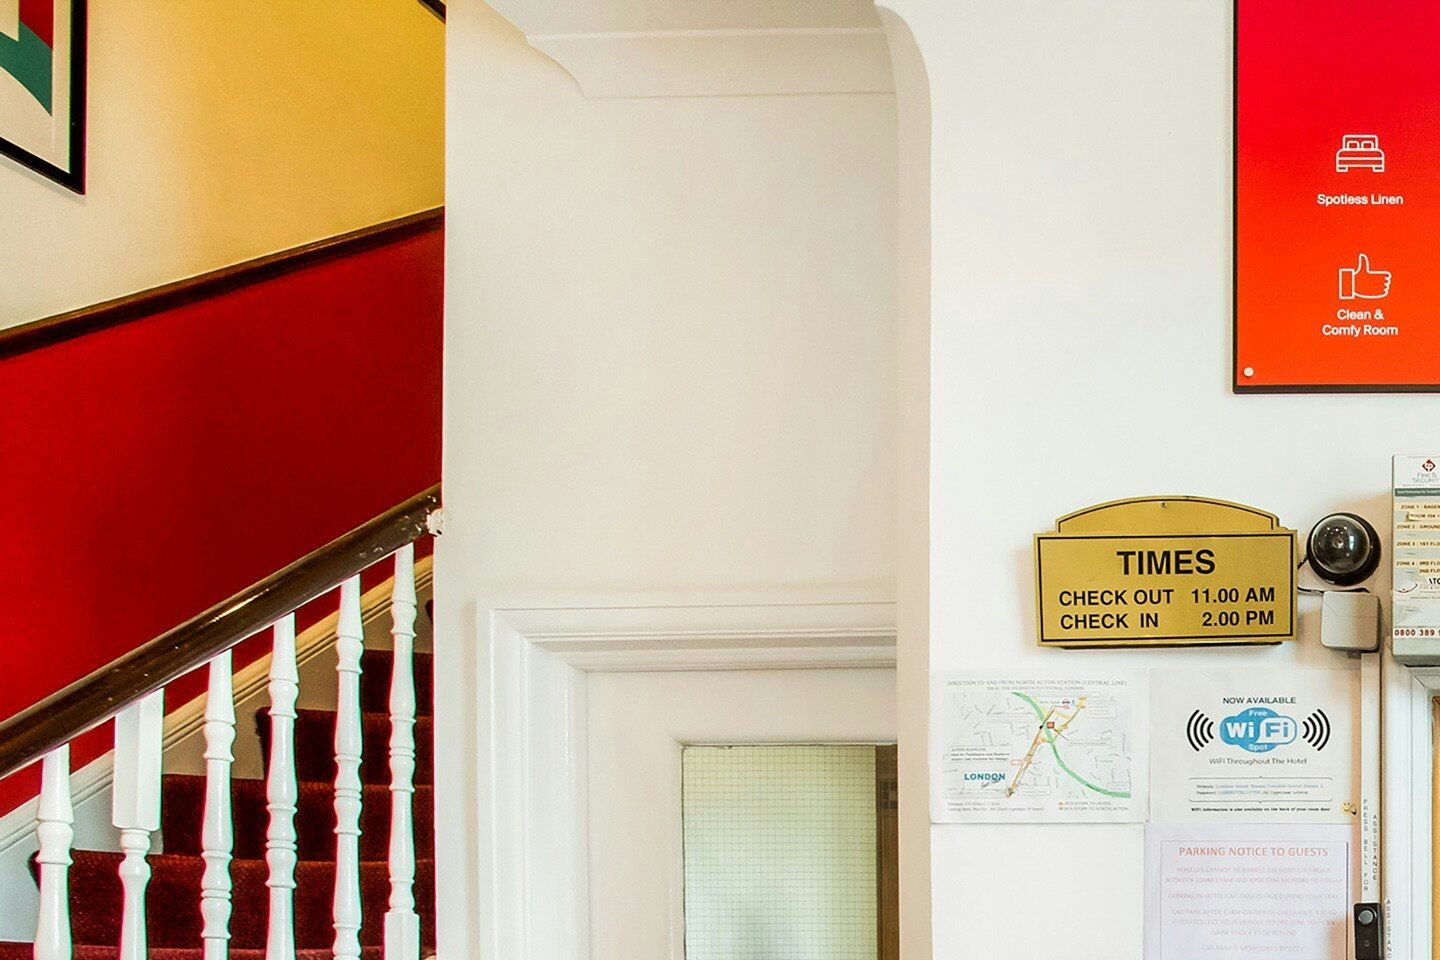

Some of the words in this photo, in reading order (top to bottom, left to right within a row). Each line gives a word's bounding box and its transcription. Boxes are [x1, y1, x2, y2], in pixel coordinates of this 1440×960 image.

[1317, 194, 1368, 206] Spotless
[1371, 194, 1404, 204] Linen
[1337, 309, 1370, 320] Clean
[1374, 309, 1383, 320] &
[1322, 324, 1361, 338] Comfy
[1363, 324, 1398, 335] Room
[1117, 549, 1216, 575] TIMES
[1059, 590, 1127, 606] CHECK
[1134, 589, 1174, 605] OUT
[1191, 589, 1239, 603] 11.00
[1245, 587, 1275, 602] AM
[1060, 614, 1128, 629] CHECK
[1140, 613, 1159, 628] IN
[1202, 612, 1239, 626] 2.00
[1246, 610, 1274, 625] PM
[1179, 847, 1225, 856] PARKING
[1229, 847, 1267, 856] NOTICE
[1272, 847, 1284, 856] TO
[1288, 848, 1328, 856] GUESTS
